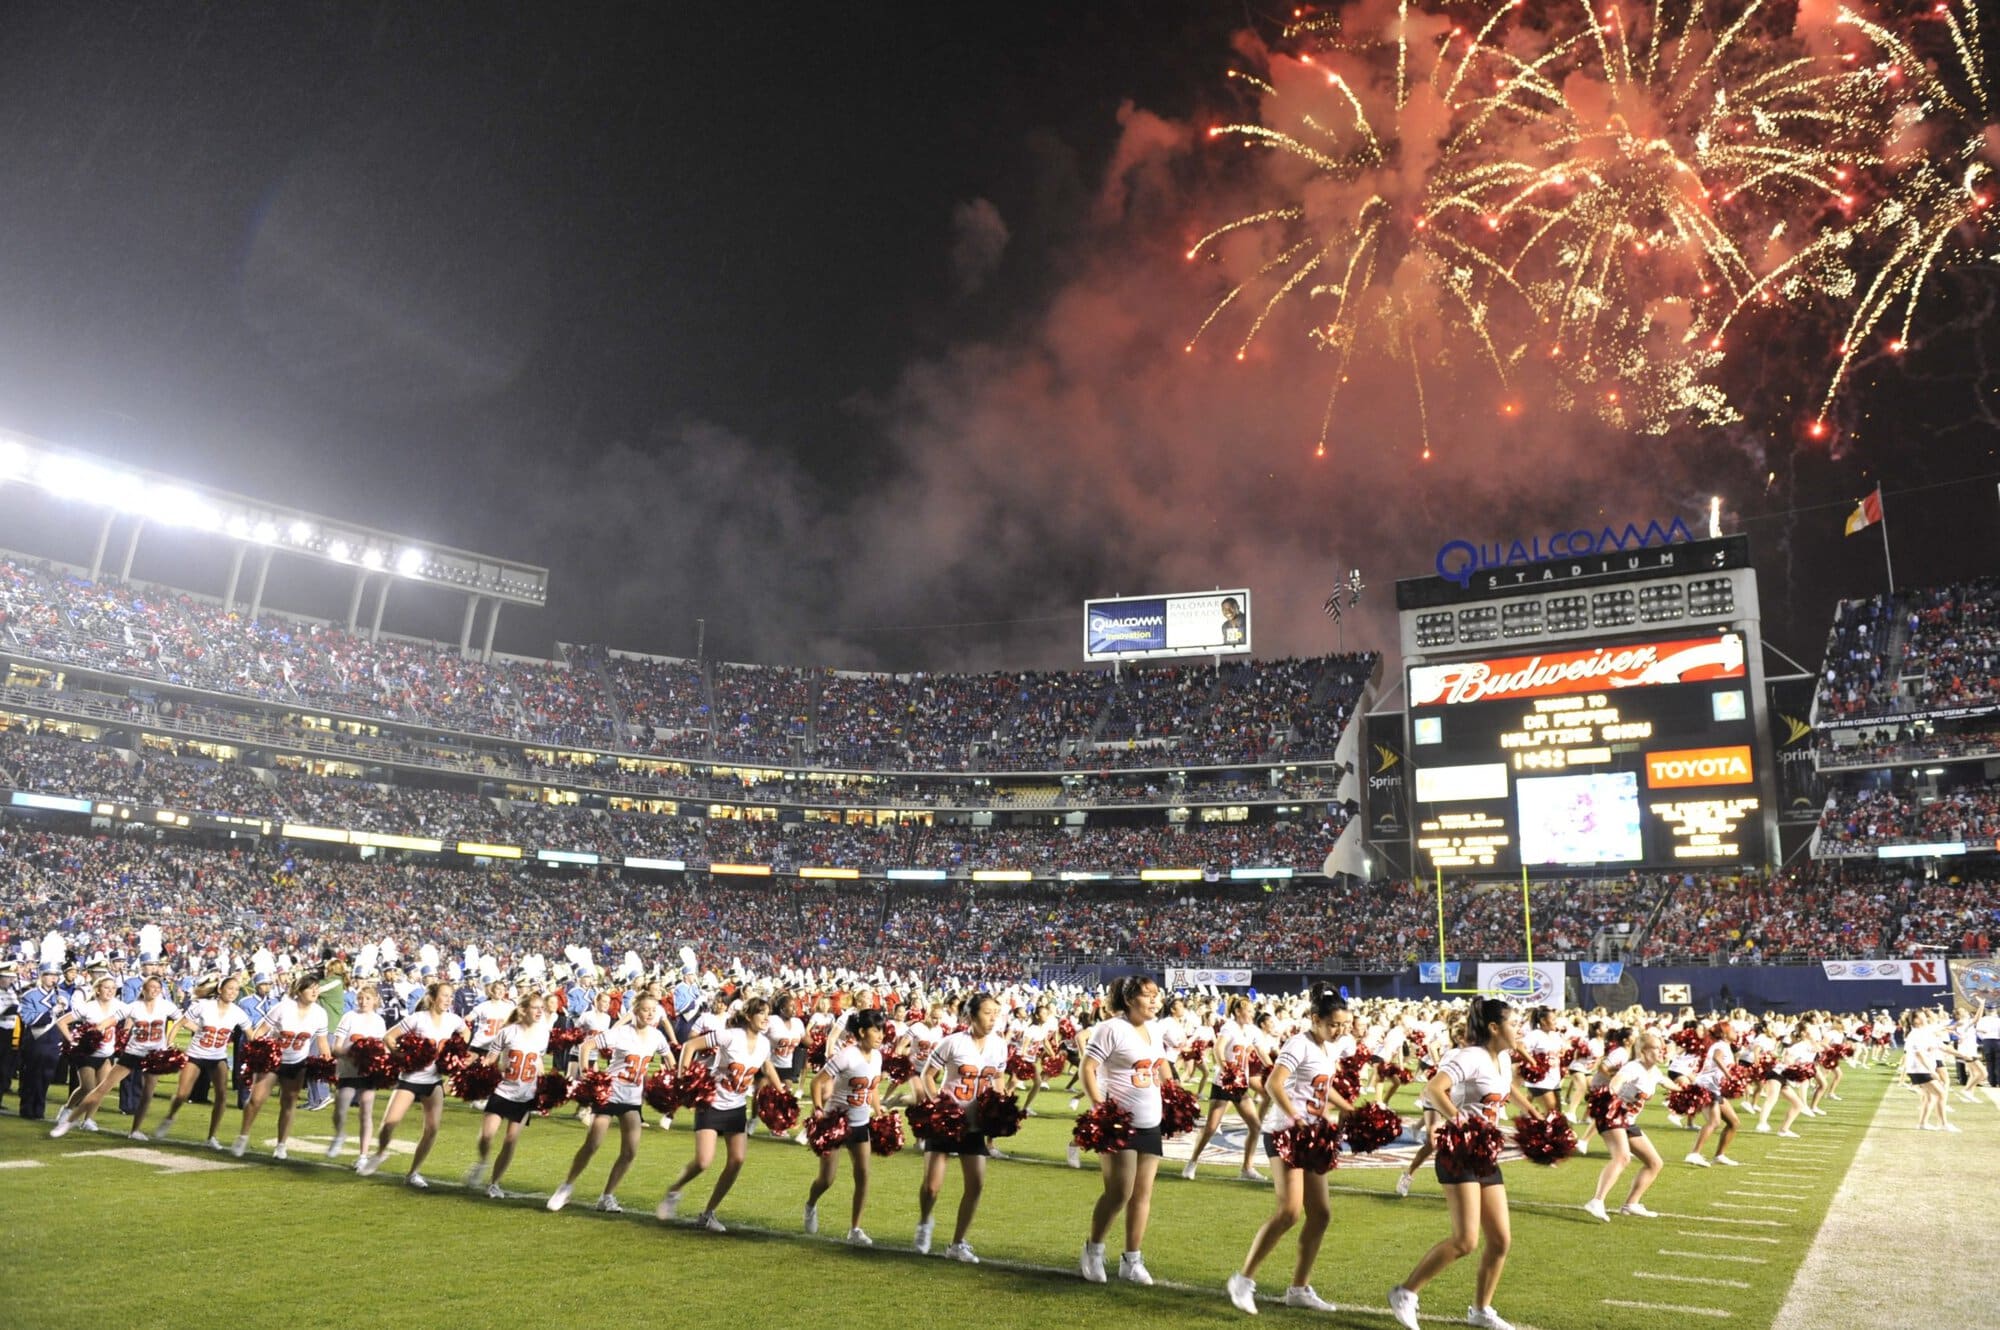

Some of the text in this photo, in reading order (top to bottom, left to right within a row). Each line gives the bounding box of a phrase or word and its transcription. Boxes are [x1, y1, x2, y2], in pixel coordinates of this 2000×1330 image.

[1436, 516, 1693, 588] QUALCOMM
[1489, 552, 1674, 587] STADIUM
[1092, 616, 1162, 633] QUALCOMM
[1441, 645, 1656, 703] Budweiser
[1587, 694, 1607, 708] TO
[1523, 708, 1619, 730] DR PEPPER
[1500, 722, 1652, 748] HALFTIME SHOW
[1651, 757, 1747, 780] TOYOTA
[1369, 775, 1402, 790] Sprint
[1172, 970, 1189, 986] A
[1910, 962, 1937, 983] N
[134, 1020, 164, 1043] 36
[505, 1049, 537, 1083] 36
